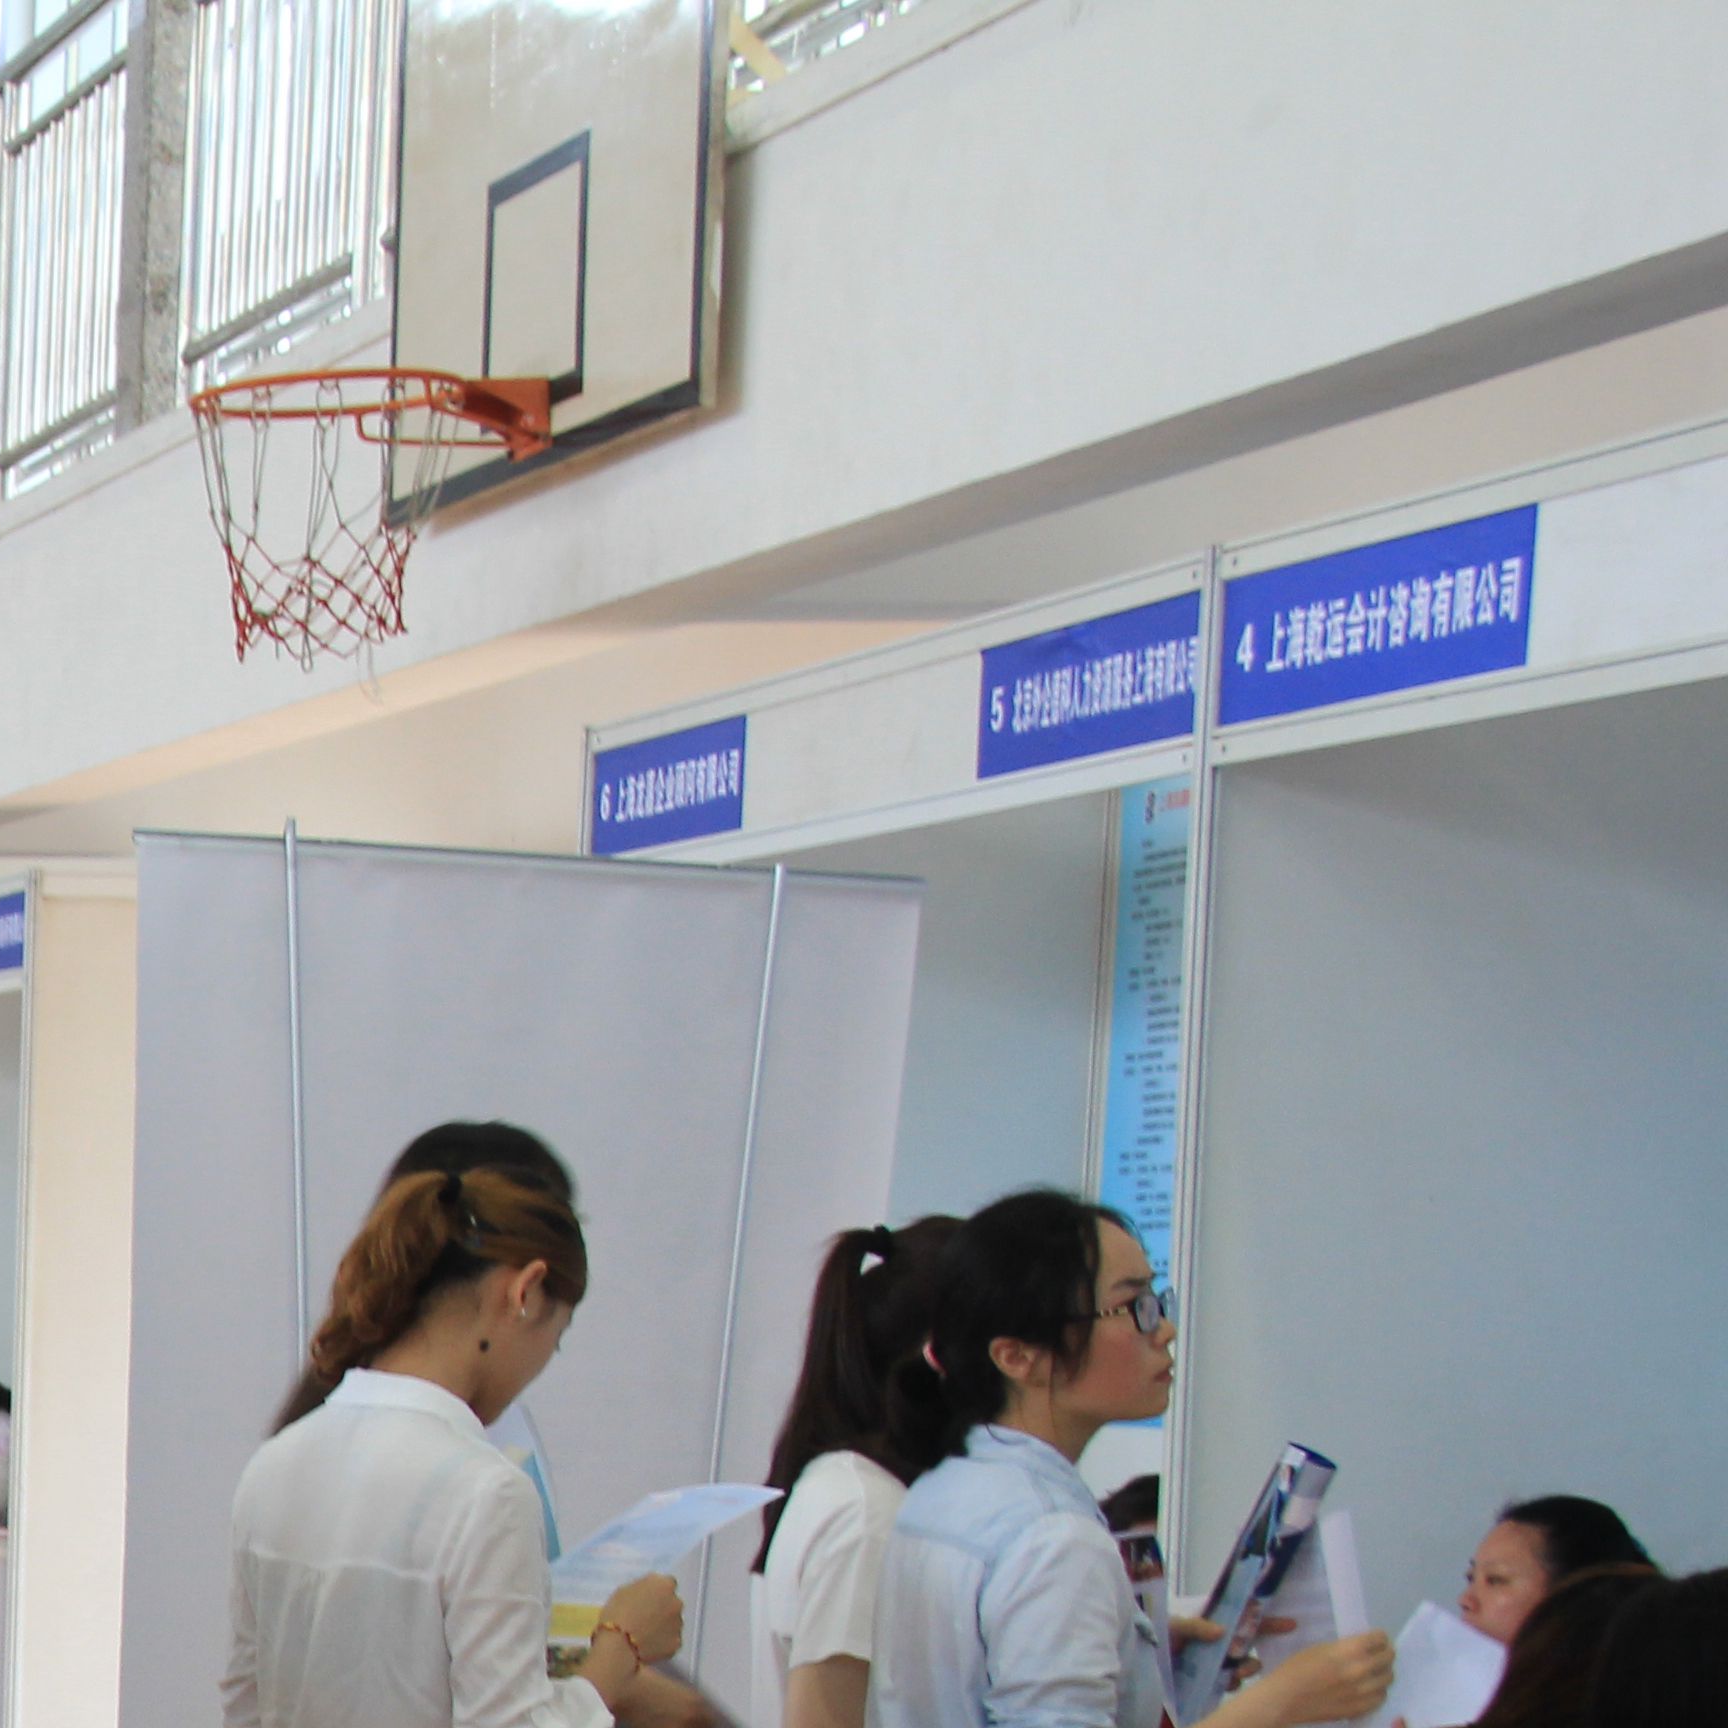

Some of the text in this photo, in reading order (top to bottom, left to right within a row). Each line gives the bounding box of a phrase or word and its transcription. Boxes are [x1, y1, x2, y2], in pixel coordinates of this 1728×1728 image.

[1235, 621, 1256, 673] 4
[989, 684, 1005, 733] 5
[599, 783, 612, 823] 6
